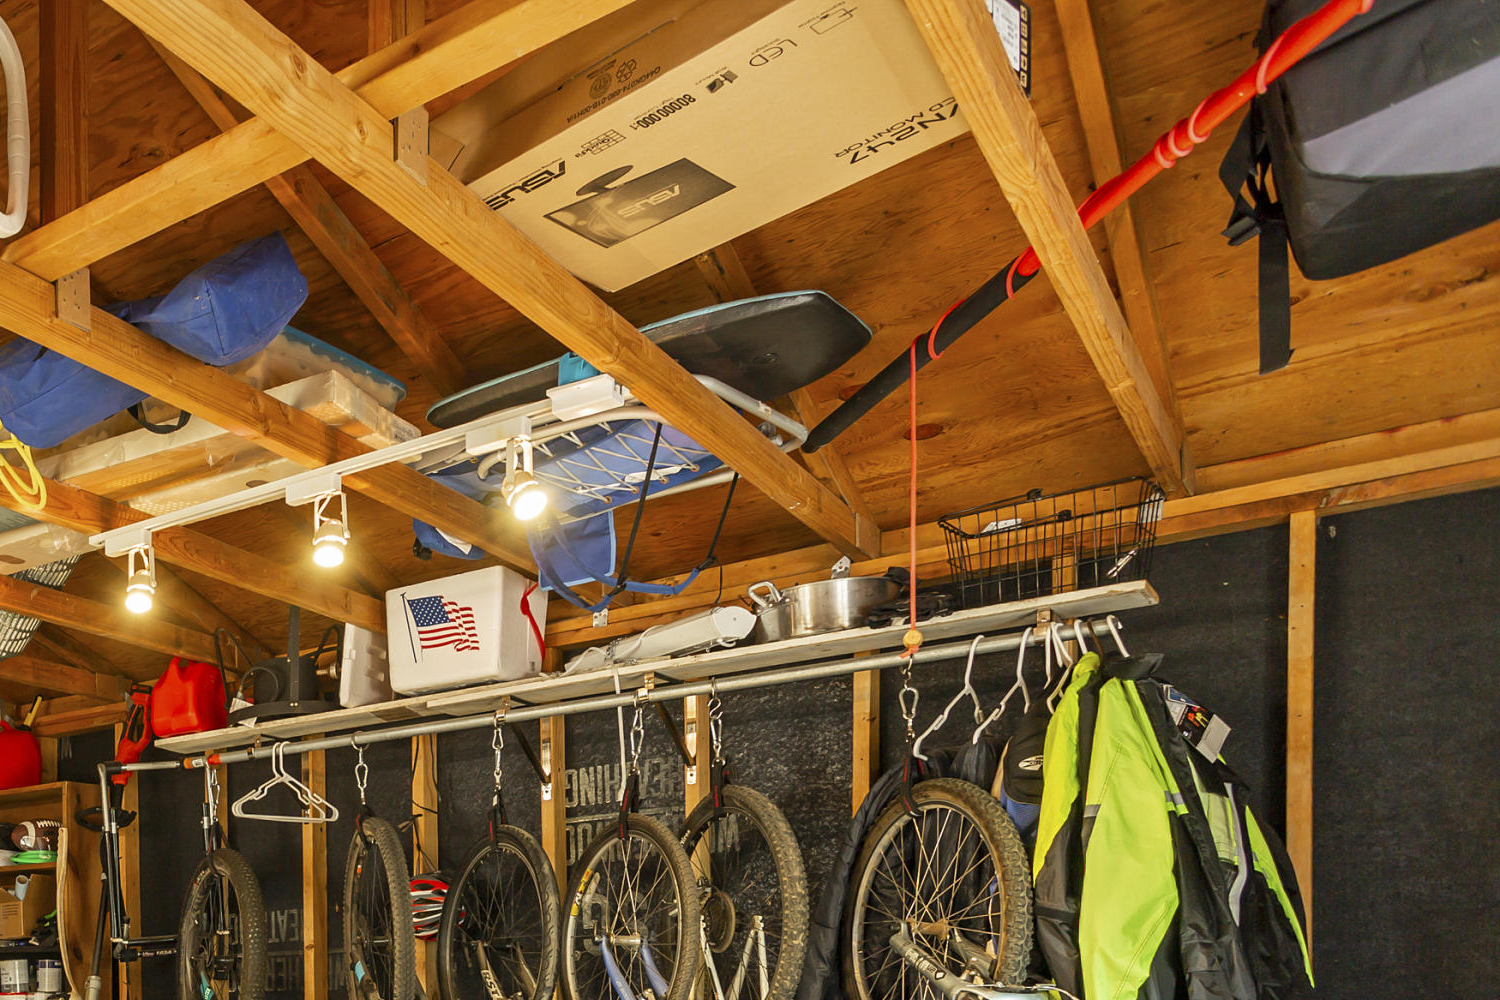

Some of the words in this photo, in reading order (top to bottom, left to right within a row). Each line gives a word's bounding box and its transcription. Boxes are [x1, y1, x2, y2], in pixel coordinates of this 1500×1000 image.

[749, 39, 798, 67] LED
[928, 96, 957, 113] CD
[835, 111, 925, 158] MONITOR
[484, 158, 566, 211] ASUS
[617, 183, 680, 218] ASUS
